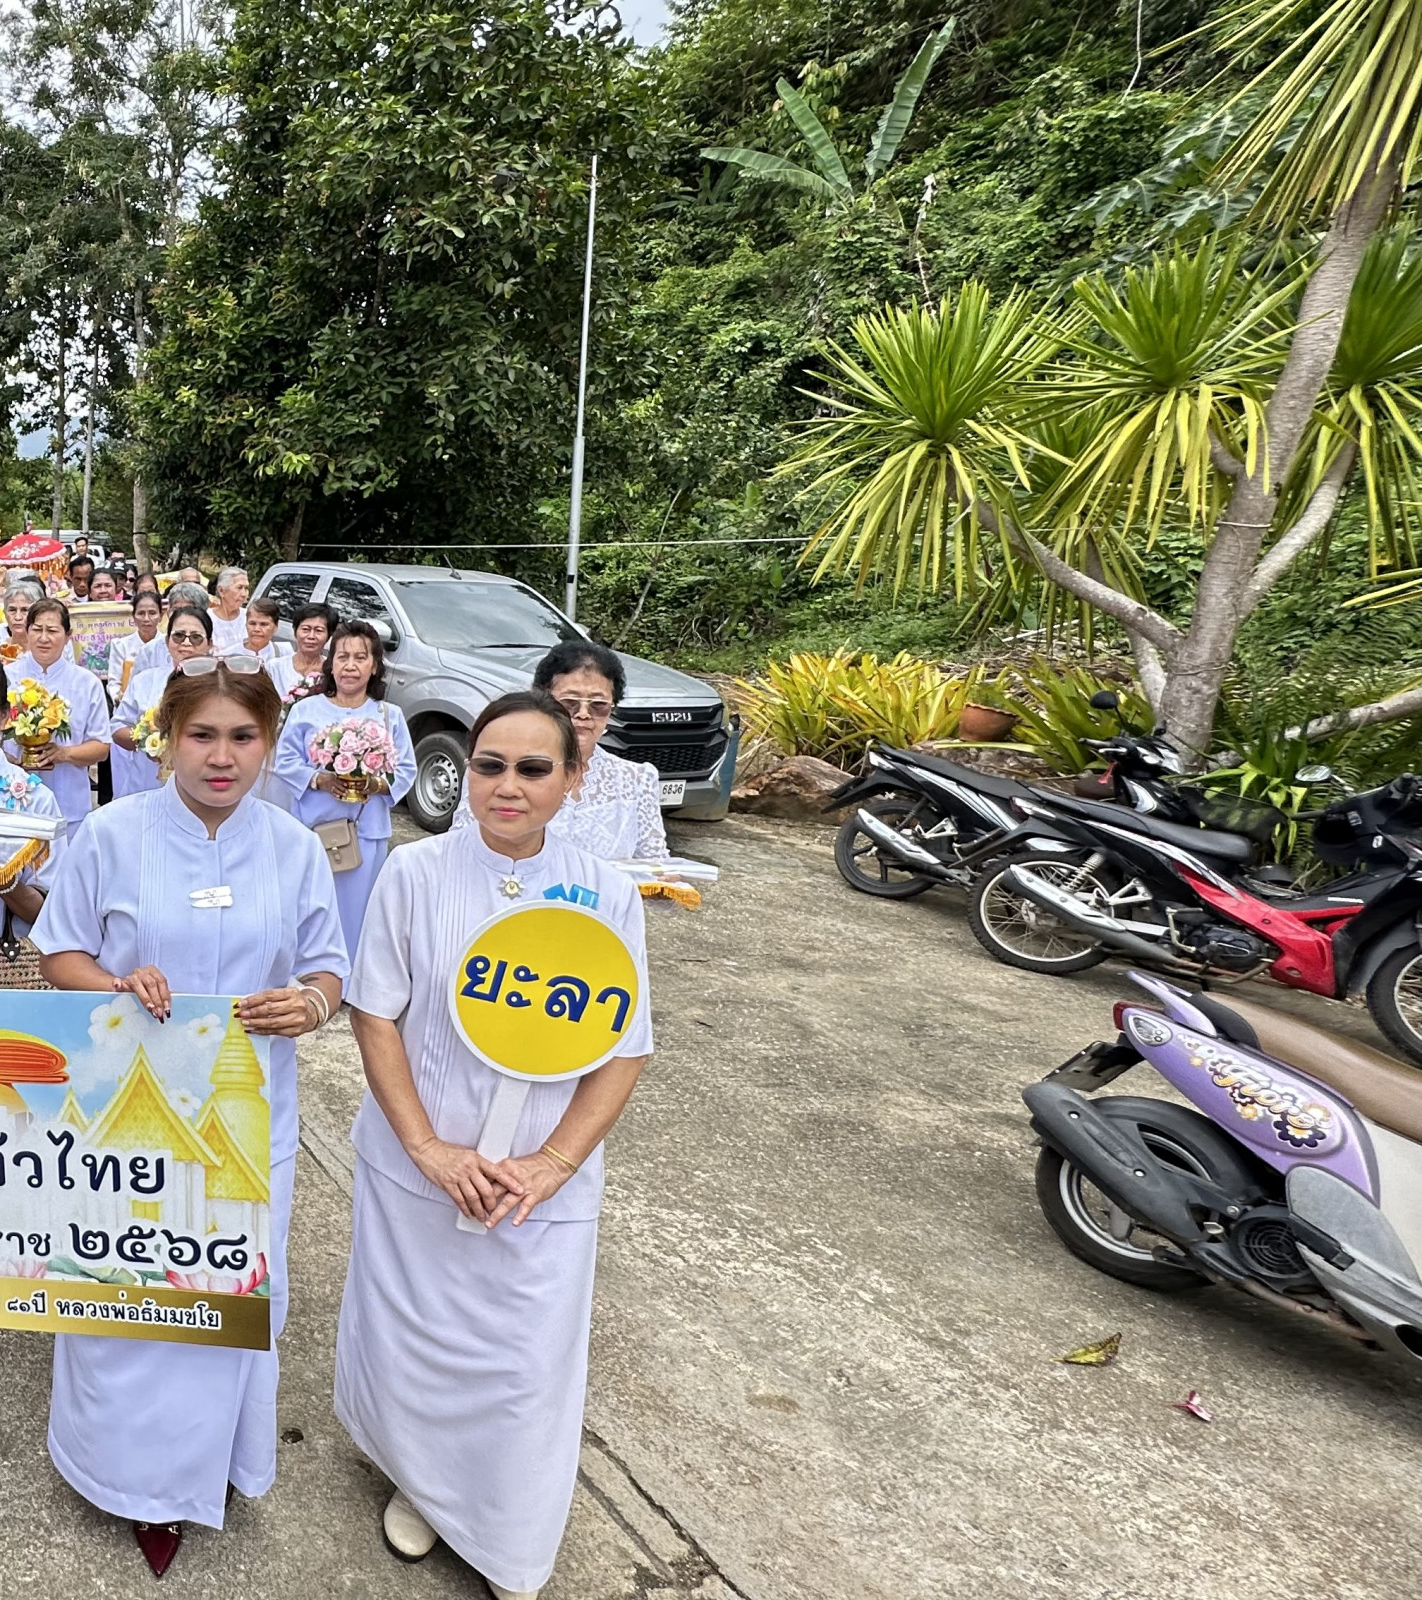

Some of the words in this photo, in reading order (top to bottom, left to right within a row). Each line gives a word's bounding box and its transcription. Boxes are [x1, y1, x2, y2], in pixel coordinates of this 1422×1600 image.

[651, 712, 692, 723] ISUZU
[662, 784, 683, 795] 6836
[460, 955, 631, 1033] ยะลา
[68, 1222, 249, 1271] ๒๕๖๘
[55, 1291, 220, 1328] หลวงพ่อธัมมชโย
